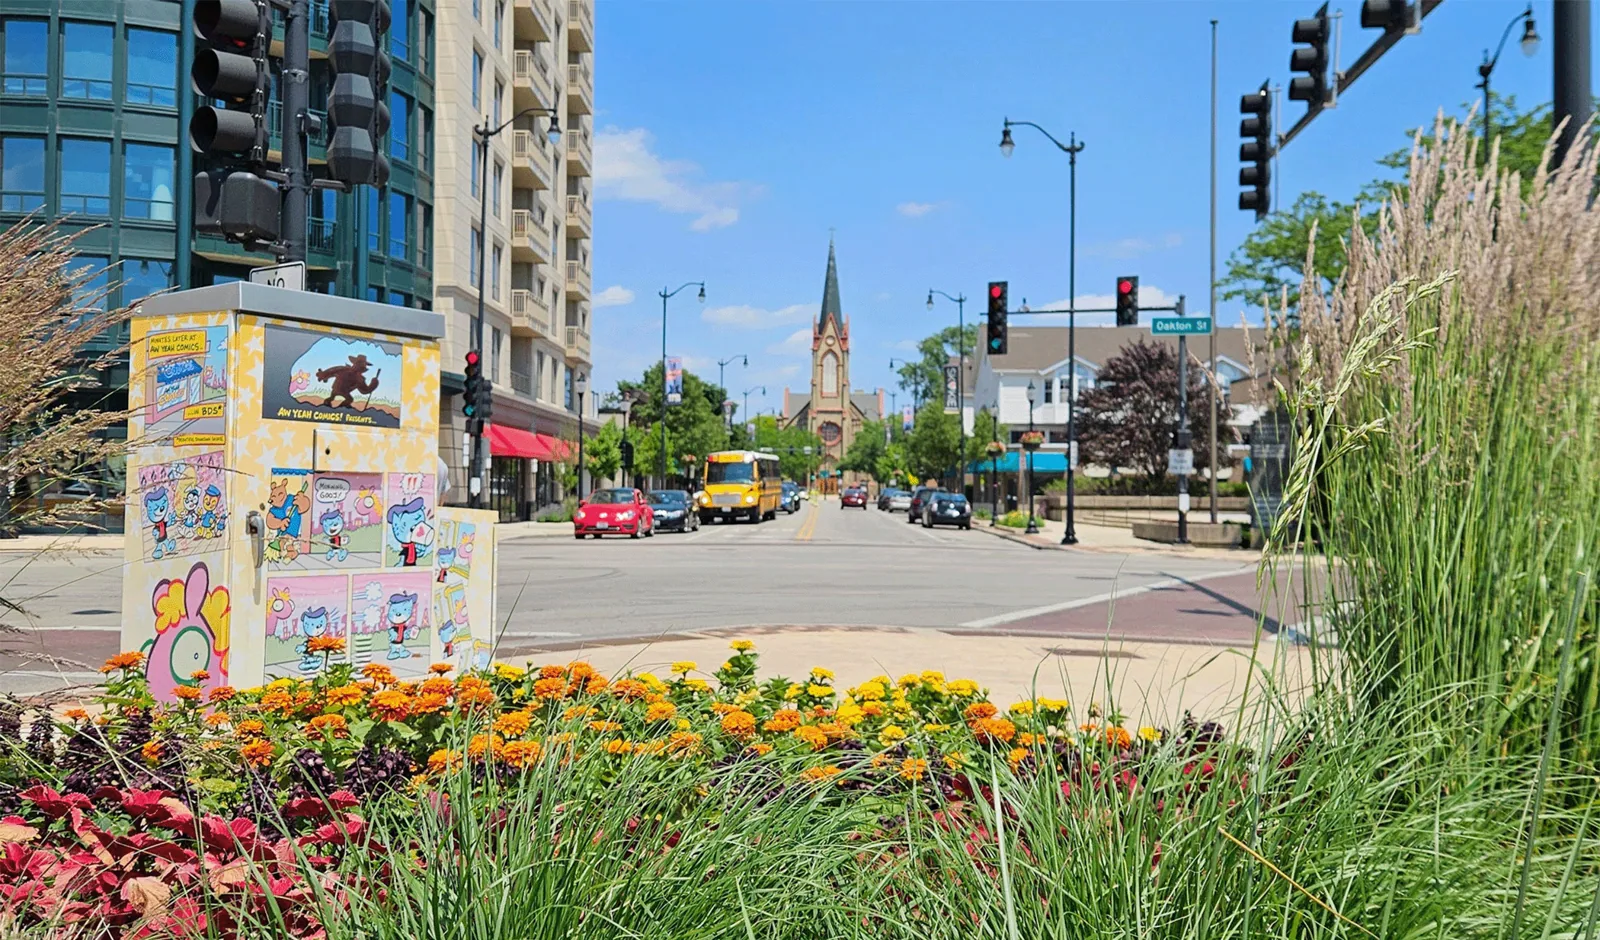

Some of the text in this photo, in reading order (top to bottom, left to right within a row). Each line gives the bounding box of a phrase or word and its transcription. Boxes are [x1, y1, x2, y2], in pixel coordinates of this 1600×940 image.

[1156, 320, 1207, 331] Oakton St
[172, 334, 188, 342] LATER
[150, 345, 160, 353] AW
[161, 344, 175, 353] YEAH
[277, 407, 292, 417] AW
[292, 409, 312, 420] YEAH
[313, 411, 343, 422] COMICS!
